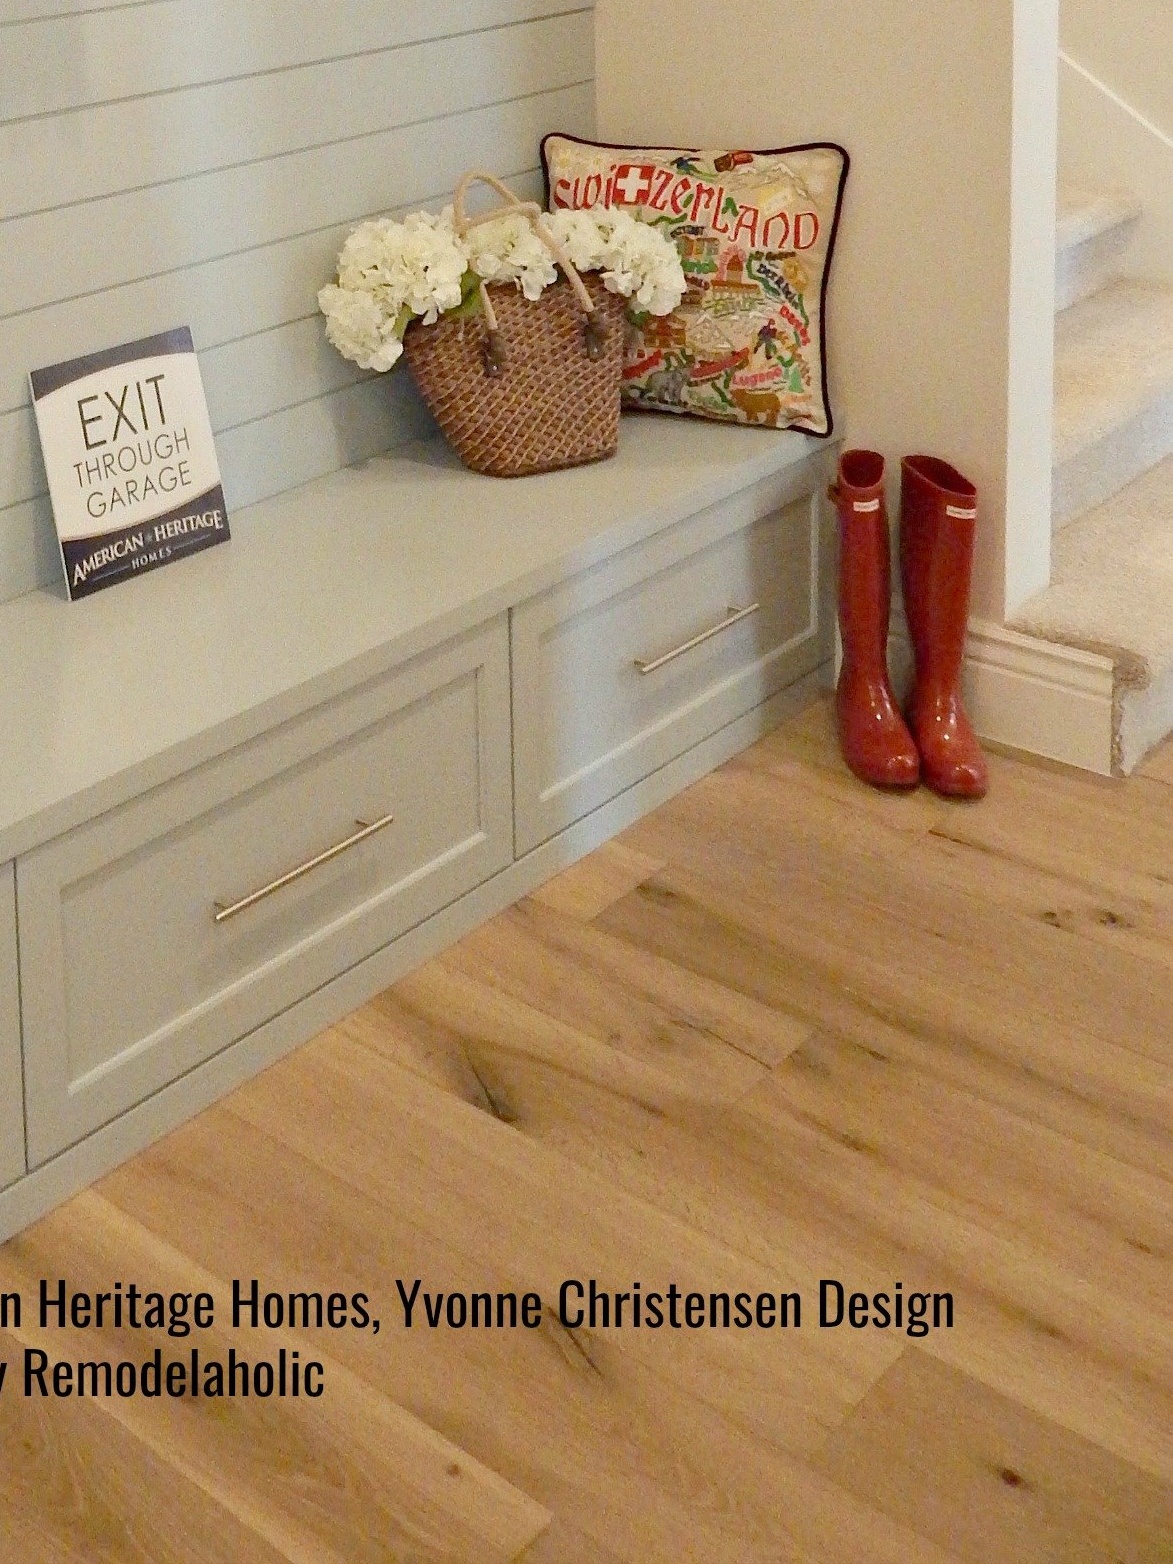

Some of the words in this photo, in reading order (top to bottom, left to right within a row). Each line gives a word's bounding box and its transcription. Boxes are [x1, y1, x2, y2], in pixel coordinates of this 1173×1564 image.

[77, 374, 165, 451] EXIT
[73, 428, 190, 488] THROUGH
[86, 460, 193, 518] GARAGE
[73, 532, 144, 586] AMERICAN
[154, 510, 223, 541] HERITAGE
[131, 545, 172, 570] HOMES
